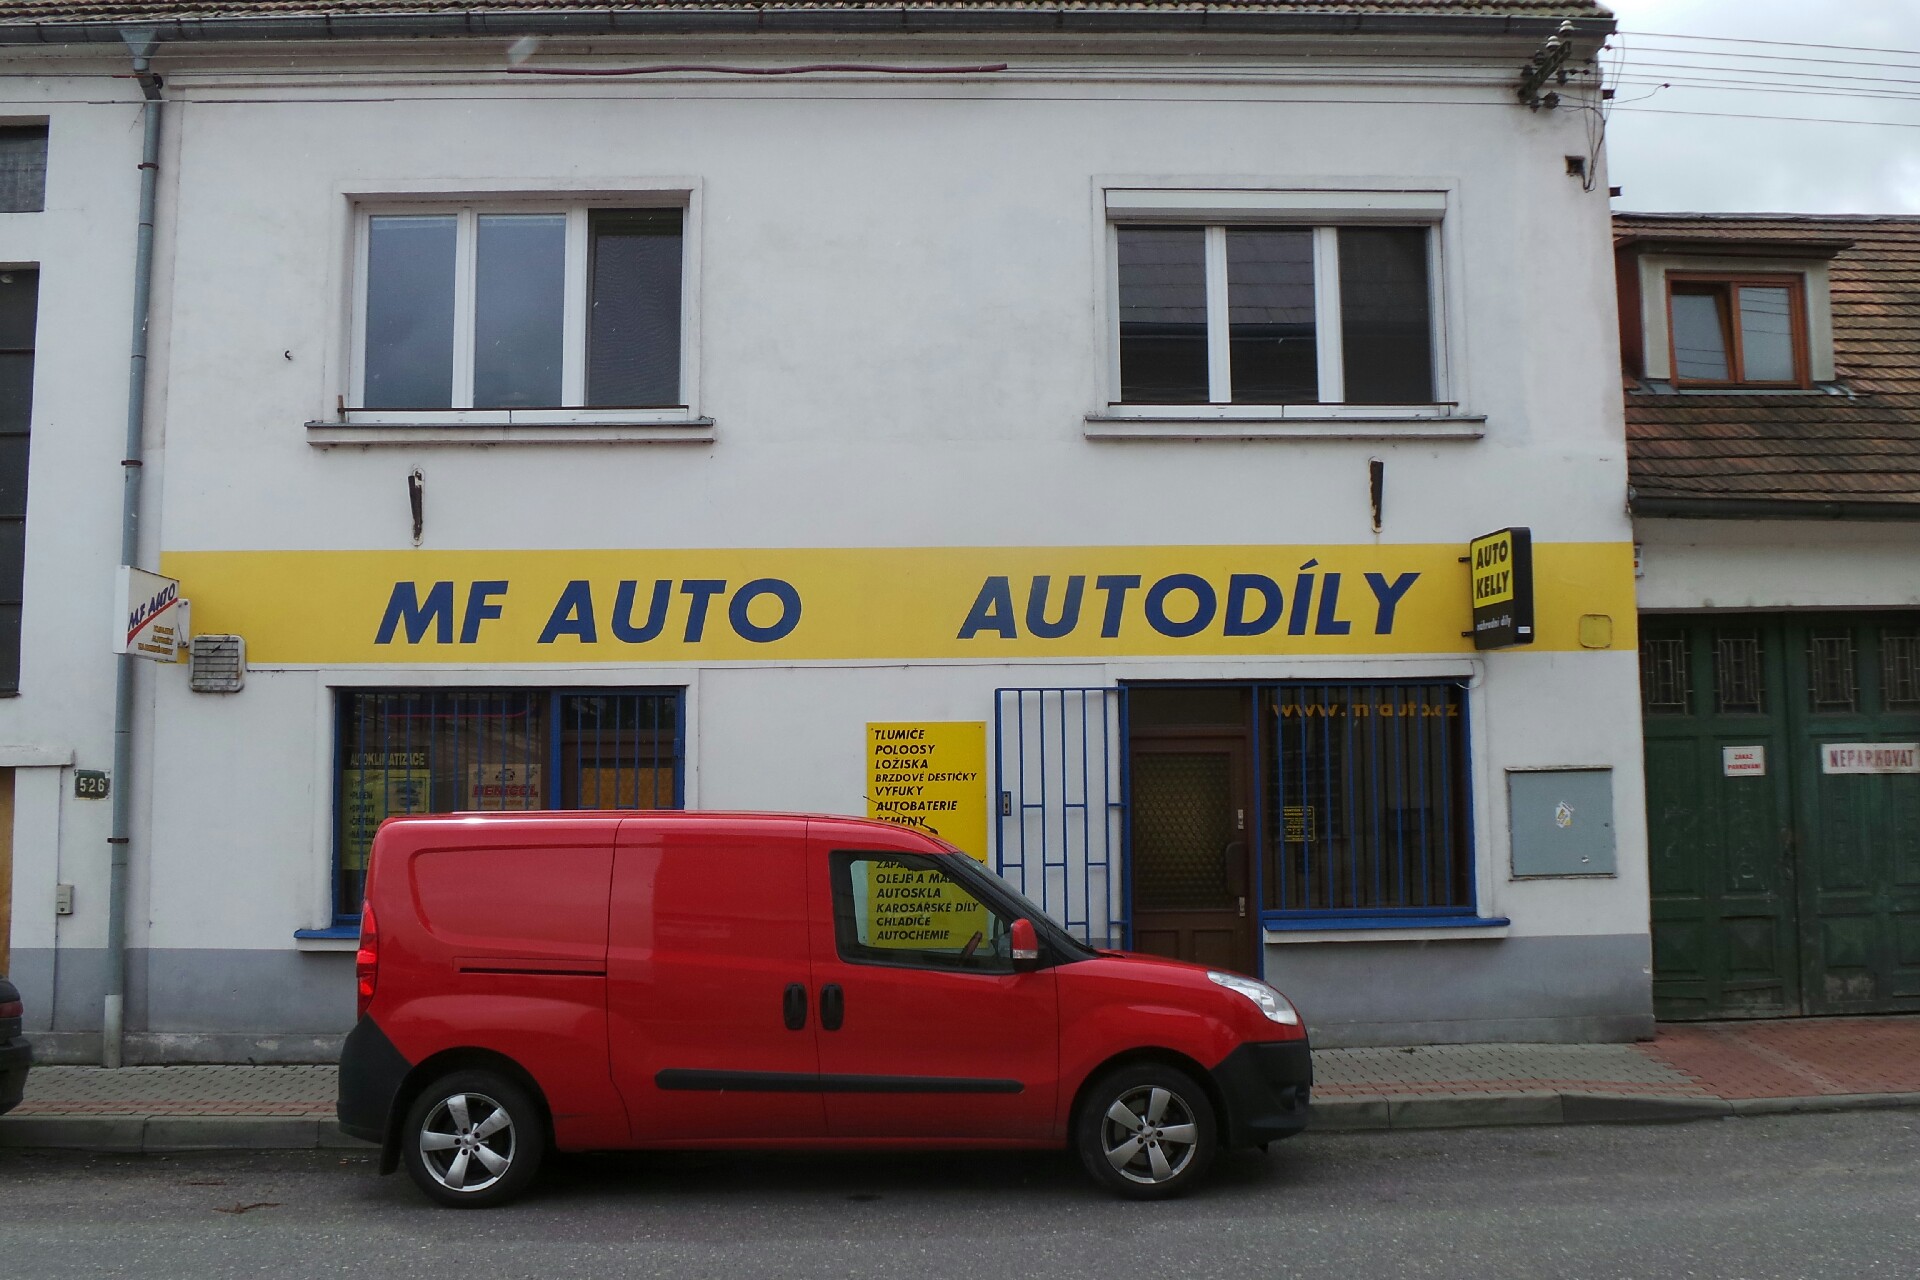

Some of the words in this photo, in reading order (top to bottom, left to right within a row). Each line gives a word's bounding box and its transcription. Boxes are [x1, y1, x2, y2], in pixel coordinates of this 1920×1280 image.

[1476, 540, 1508, 570] AUTO
[1476, 570, 1510, 599] KELLY
[373, 580, 509, 644] MF
[536, 578, 802, 644] AUTO
[956, 558, 1421, 639] AUTODÍLY
[127, 603, 146, 632] MF
[148, 583, 176, 616] AUTO
[1272, 702, 1458, 717] www.mauto.cz
[874, 728, 925, 740] TLUMIČE
[875, 744, 936, 755] POLOOSY
[875, 757, 929, 769] LOŽISKA
[875, 771, 925, 782] BRZDOVÉ
[927, 771, 977, 781] DESTIČKY
[79, 777, 105, 792] 526
[875, 783, 924, 796] VÝFUKY
[875, 800, 958, 811] AUTOBATERIE
[876, 873, 913, 884] OLEJE
[916, 873, 924, 883] A
[876, 888, 941, 898] AUTOSKLA
[955, 900, 979, 912] DÍLY
[876, 914, 931, 926] CHLADIČE
[876, 930, 950, 940] AUTOCHEMIE
